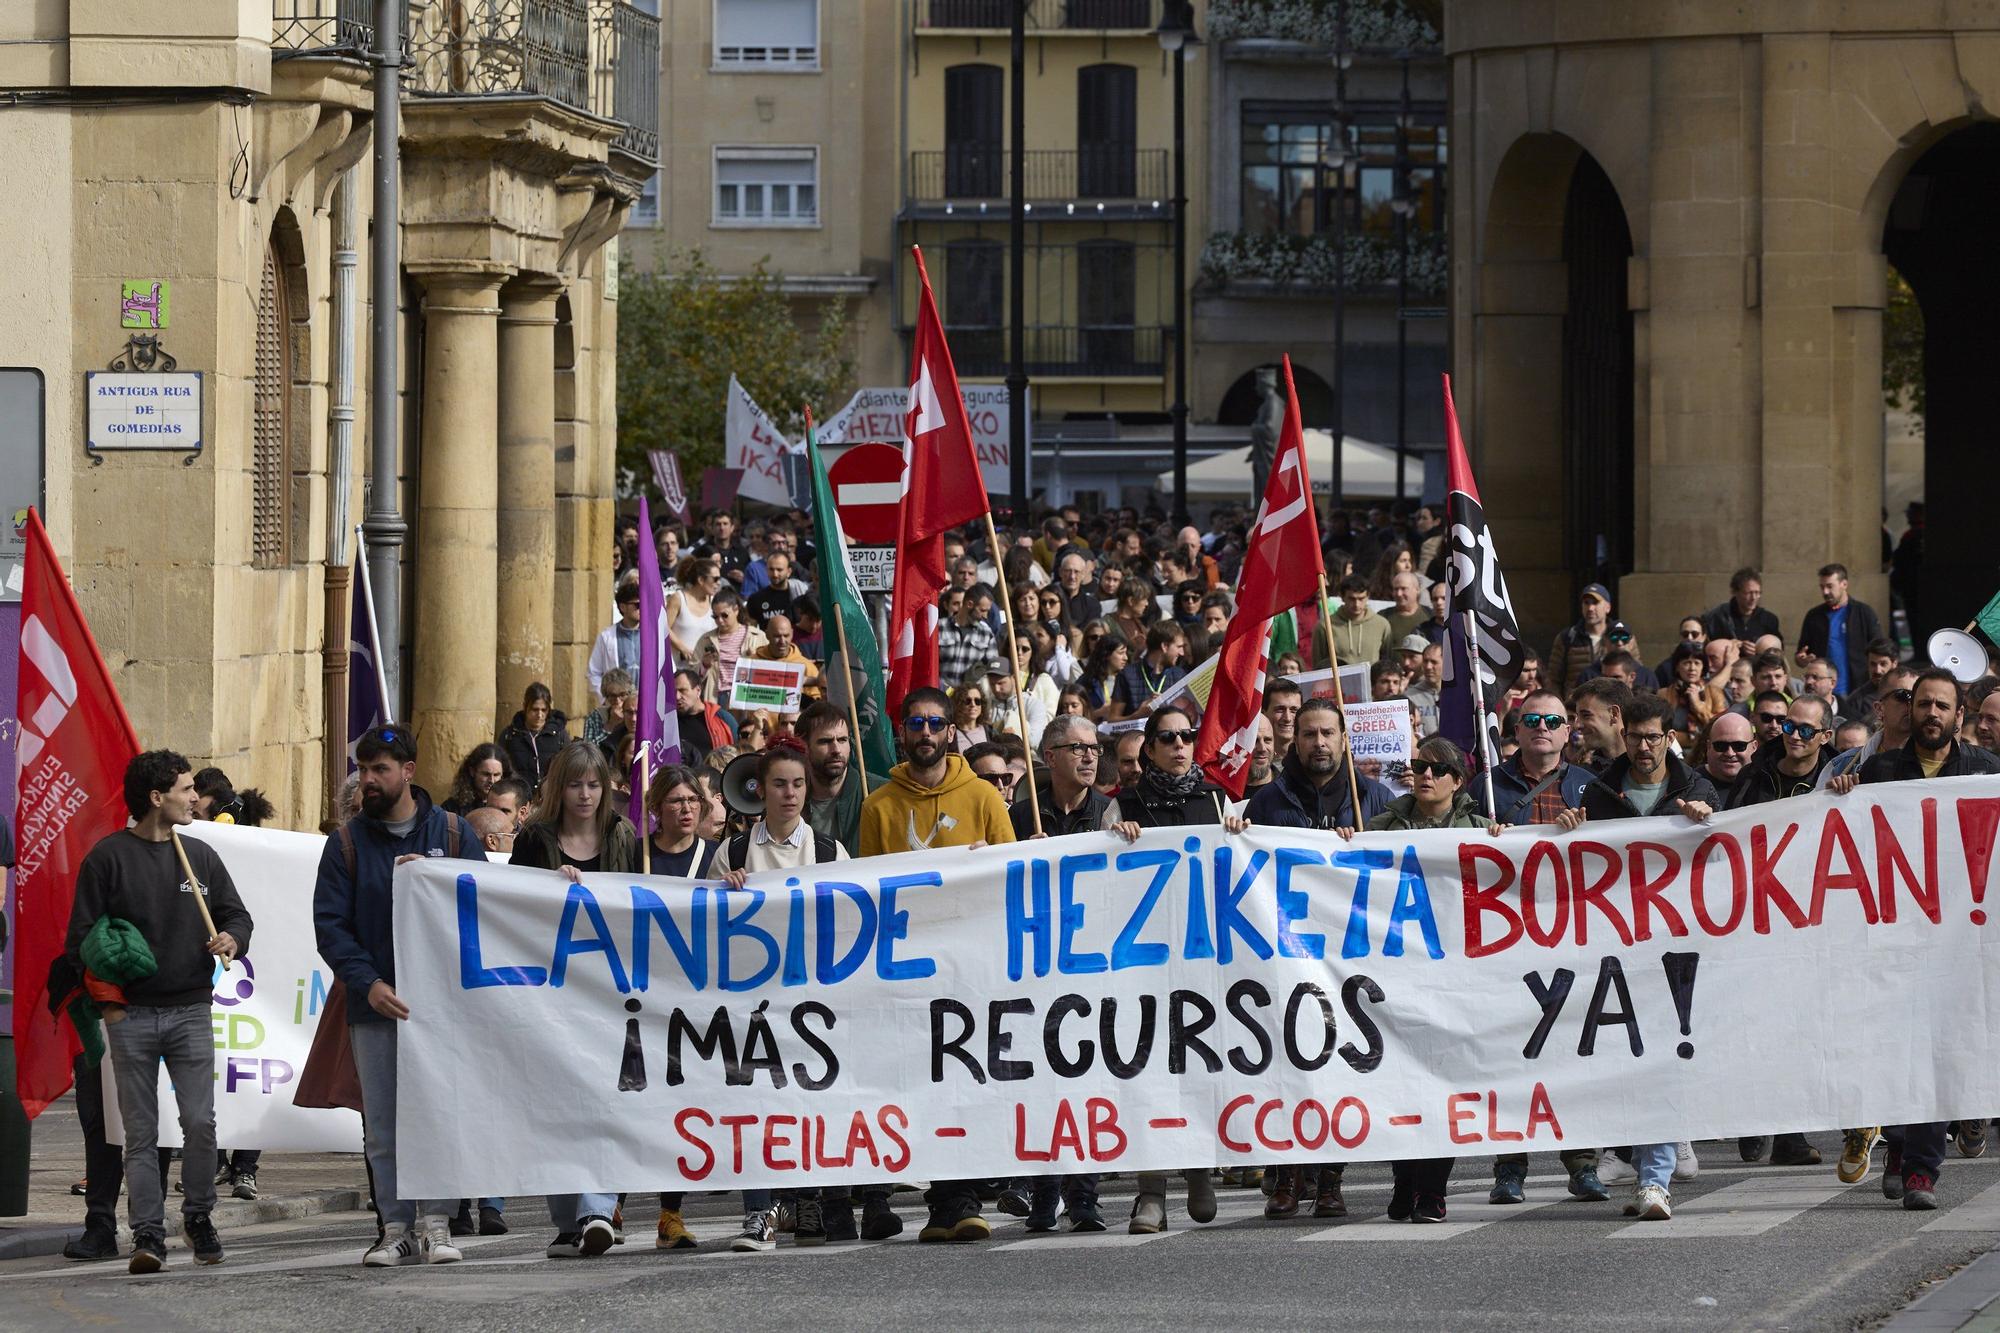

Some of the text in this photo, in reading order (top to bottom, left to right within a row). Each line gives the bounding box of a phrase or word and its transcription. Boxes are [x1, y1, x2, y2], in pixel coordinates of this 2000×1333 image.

[98, 386, 192, 397] ANTIGUA RUA
[135, 405, 155, 415] DE
[107, 424, 183, 434] COMEDIAS
[1351, 720, 1397, 733] GREBA
[617, 951, 1701, 1093] ¡MÁS RECURSOS YA!
[674, 1105, 913, 1182] STEILAS
[1015, 1096, 1128, 1162] LAB
[1218, 1094, 1371, 1153] CCOO
[1448, 1082, 1565, 1145] ELA
